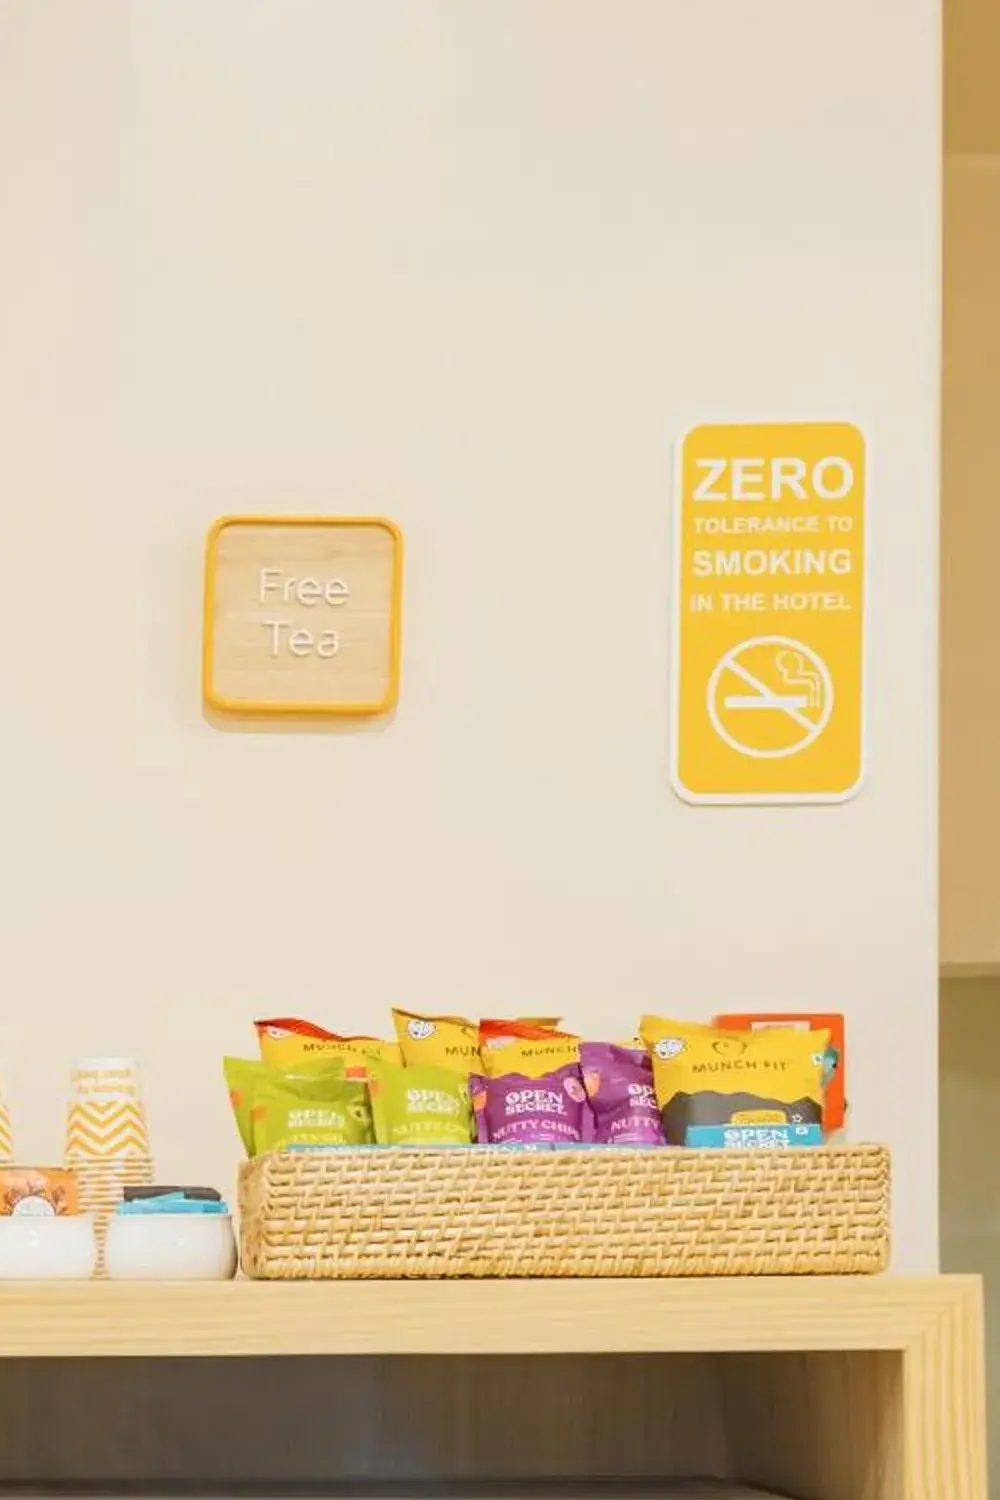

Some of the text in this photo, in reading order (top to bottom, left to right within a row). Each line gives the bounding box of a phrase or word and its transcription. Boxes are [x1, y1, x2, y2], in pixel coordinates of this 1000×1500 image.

[692, 456, 855, 502] ZERO
[695, 515, 853, 534] TOLERANCE TO
[692, 549, 853, 577] SMOKING
[259, 567, 350, 607] Free
[690, 591, 853, 612] IN THE HOTEL
[263, 620, 340, 659] Tea
[445, 1046, 481, 1057] MUN
[692, 1059, 757, 1073] MUNCH
[505, 1089, 563, 1106] OPEN
[627, 1083, 654, 1097] OP
[723, 1127, 788, 1141] OPEN
